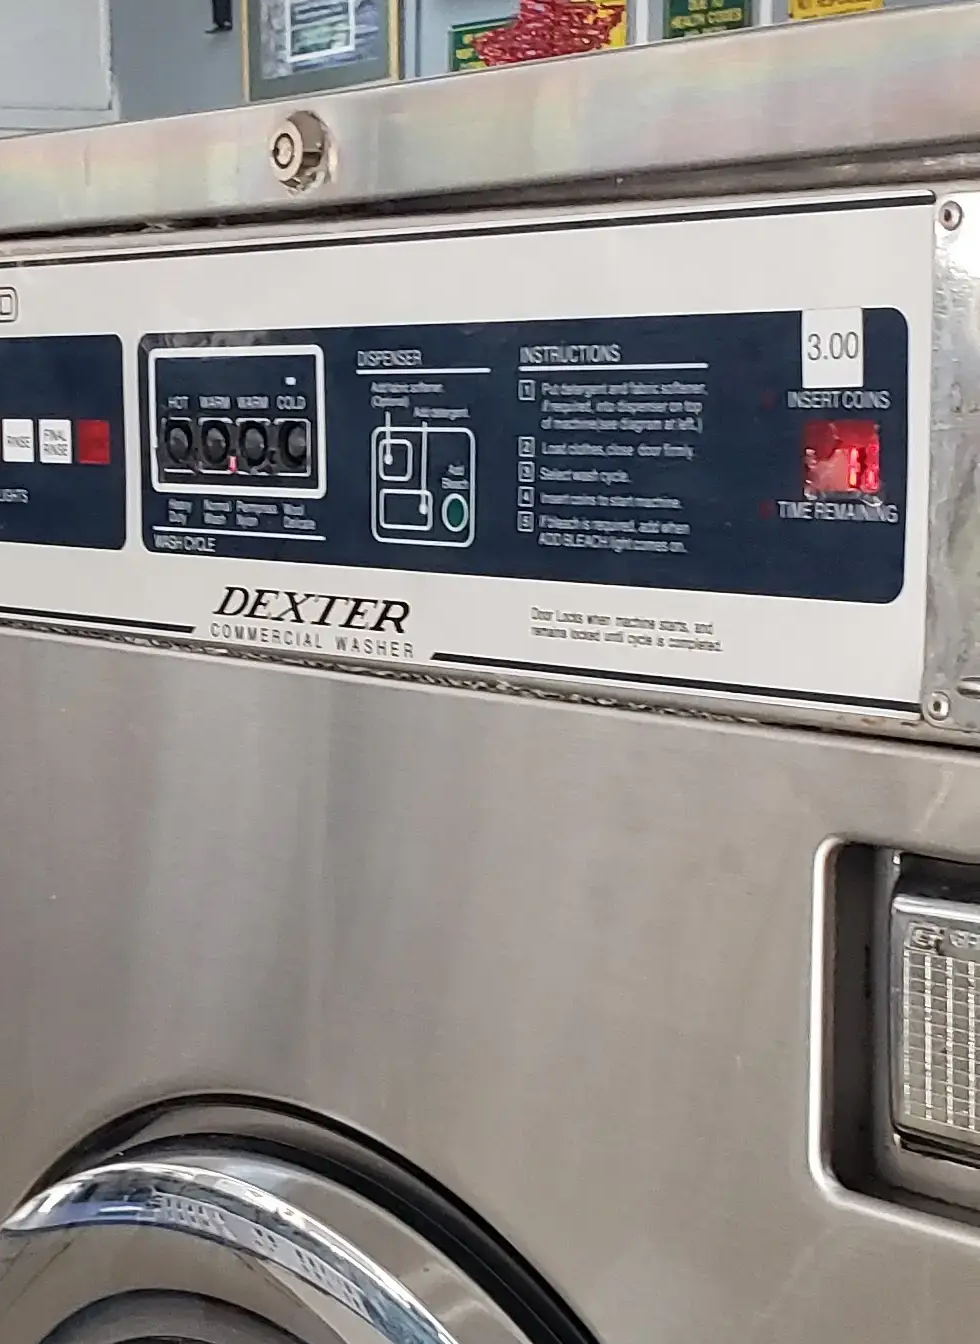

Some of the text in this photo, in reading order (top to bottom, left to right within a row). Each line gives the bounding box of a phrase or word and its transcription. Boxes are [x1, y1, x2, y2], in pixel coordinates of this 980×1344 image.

[520, 343, 621, 364] INSTRUCTIONS
[807, 331, 859, 360] 3.00
[357, 349, 422, 367] DISPENSER
[168, 395, 307, 410] HOT WARM WARM COLD
[787, 389, 891, 410] INSERT COINS
[6, 433, 32, 449] RINSE
[42, 428, 67, 442] FINAL
[42, 442, 68, 457] RINSE
[777, 500, 899, 523] TIME REMAINING
[154, 533, 217, 552] WASH CYCLE
[212, 585, 410, 634] DEXTER
[531, 607, 554, 622] Door
[210, 622, 414, 659] COMMERCIAL WASHER
